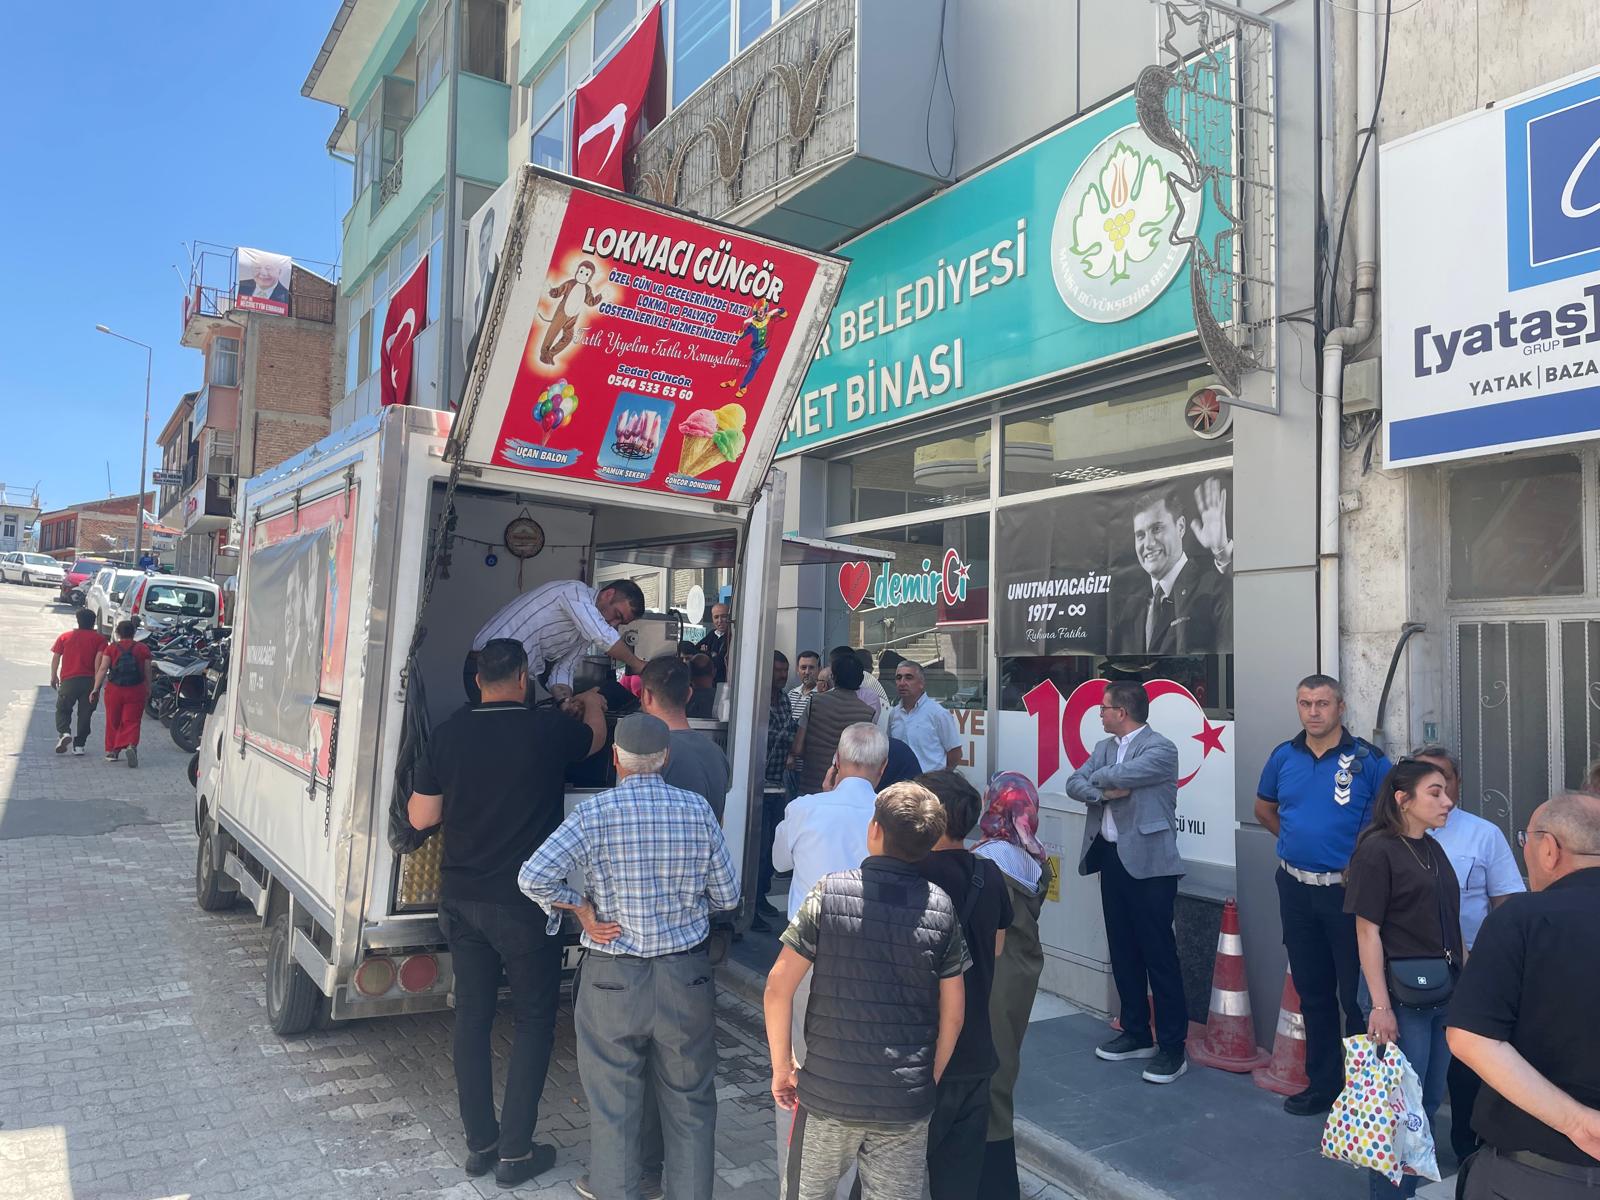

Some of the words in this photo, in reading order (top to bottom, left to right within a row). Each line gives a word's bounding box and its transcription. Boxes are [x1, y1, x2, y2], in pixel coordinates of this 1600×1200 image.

[582, 227, 695, 279] LOKMACI
[693, 239, 784, 304] GÜNGÖR
[608, 268, 630, 286] ÖZEL
[632, 274, 652, 292] GÜN
[653, 282, 664, 294] ve
[665, 285, 728, 311] GECELERİNİZDE
[728, 302, 751, 317] TATLI
[839, 217, 1029, 350] BELEDİYESİ
[637, 294, 668, 314] LOKMA
[669, 303, 680, 316] ve
[681, 307, 717, 326] PALYAÇO
[605, 331, 649, 357] Yiyelim
[1523, 340, 1560, 356] GRUP
[607, 374, 636, 389] 0544
[678, 388, 693, 401] 60
[617, 364, 650, 378] Sedat
[651, 370, 693, 387] GÜNGÖR
[846, 337, 964, 422] BİNASI
[1469, 371, 1533, 397] YATAK
[1545, 359, 1599, 383] BAZA
[516, 446, 539, 460] UÇAN
[540, 450, 568, 464] BALON
[602, 466, 625, 477] PAMUK
[1007, 571, 1112, 600] UNUTMAYACAĞIZ!
[1028, 603, 1057, 622] 1977
[1058, 626, 1088, 639] Fatiha
[1188, 819, 1206, 835] YILI
